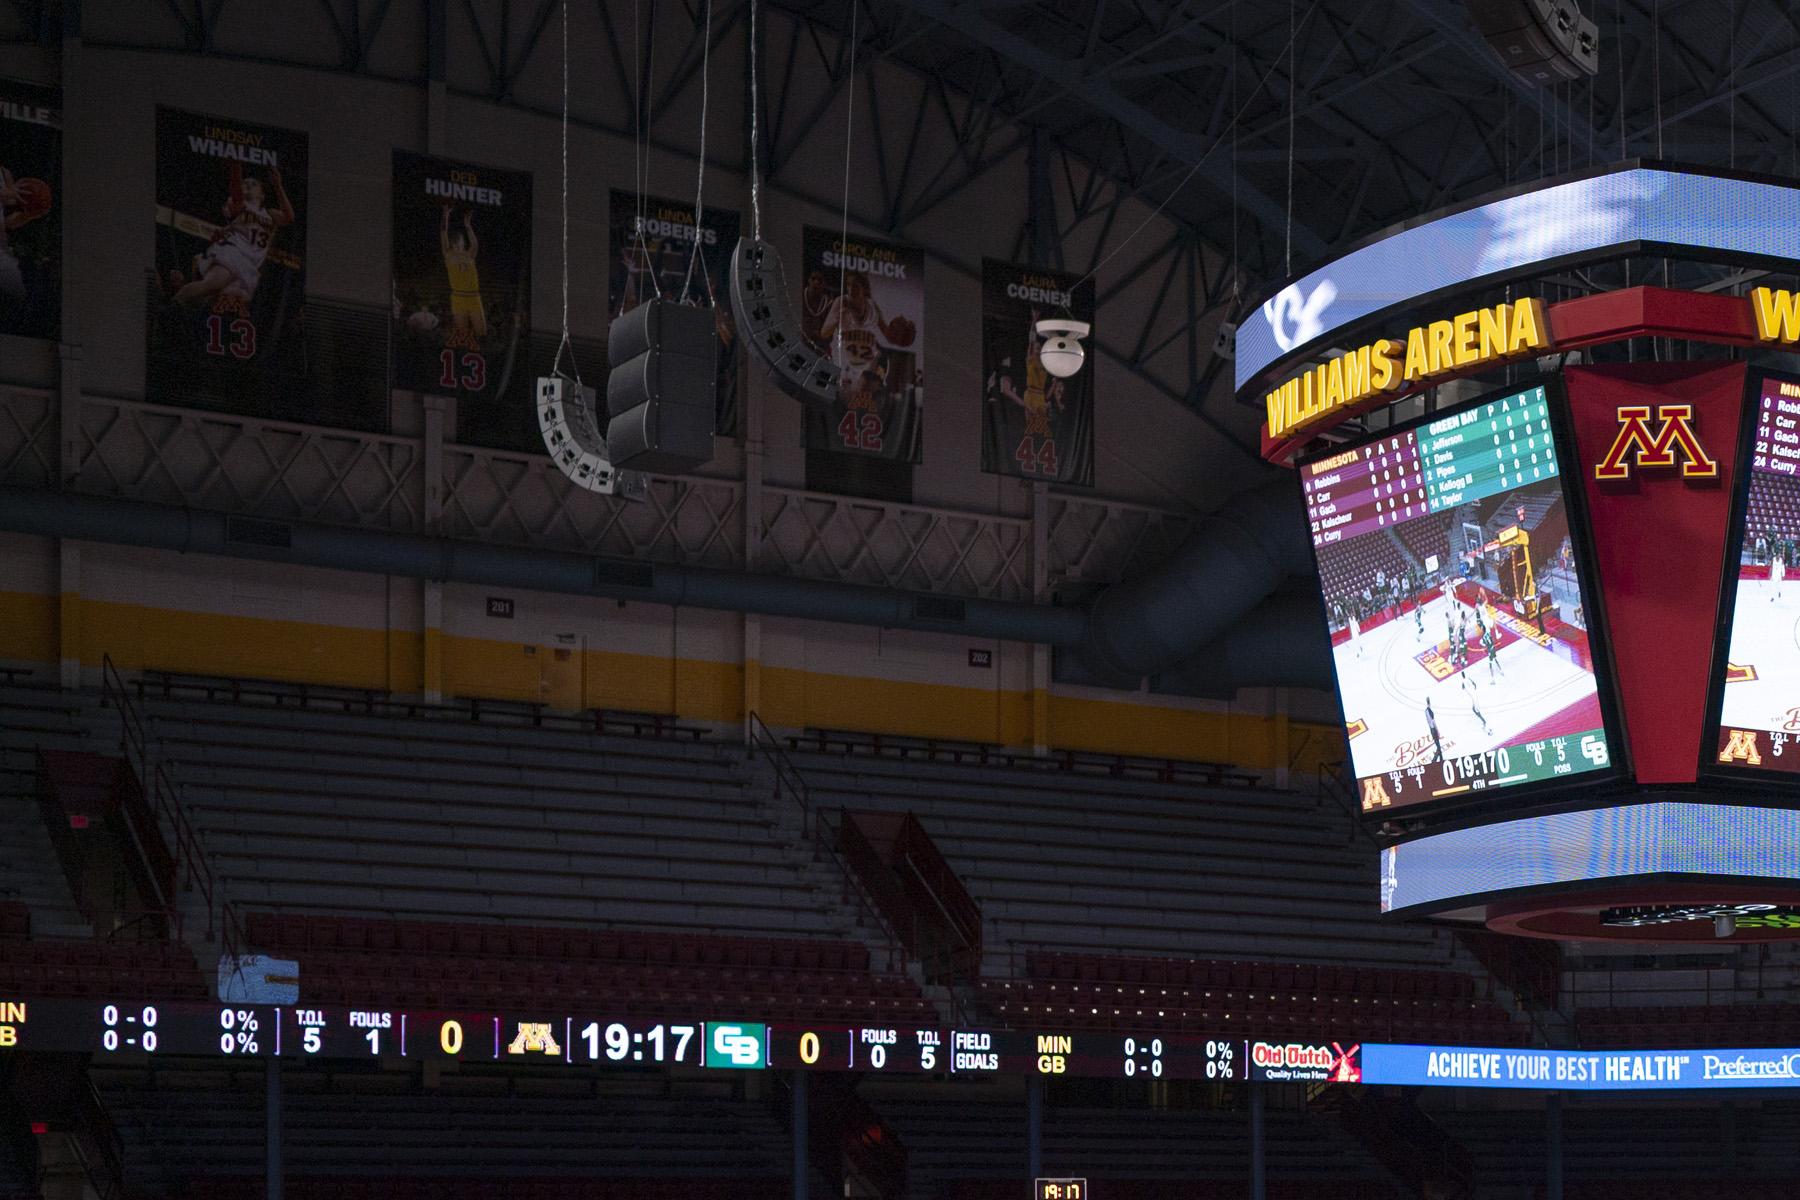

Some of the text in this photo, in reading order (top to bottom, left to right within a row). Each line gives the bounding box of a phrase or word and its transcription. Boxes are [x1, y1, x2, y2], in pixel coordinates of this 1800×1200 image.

[204, 126, 263, 148] LINDSAY
[189, 135, 278, 166] WHALEN
[450, 170, 478, 184] DEB
[426, 177, 501, 206] HUNTER
[657, 208, 693, 223] LINDA
[634, 215, 717, 245] ROBERTS
[822, 250, 905, 280] SHUDLICK
[206, 315, 256, 358] 13
[440, 349, 487, 390] 13
[1266, 297, 1545, 438] WILLIAMS ARENA
[838, 412, 883, 450] 42
[1776, 415, 1796, 429] Carr
[1756, 441, 1768, 453] 22
[1774, 430, 1799, 444] Gach
[1016, 435, 1058, 475] 44
[1312, 450, 1359, 475] MINNESOTA
[1754, 456, 1797, 473] 24 Curry
[220, 1009, 259, 1030] 0%
[350, 1011, 392, 1028] FOULS
[220, 1032, 259, 1053] 0%
[303, 1028, 321, 1053] 5
[366, 1029, 379, 1054] 1
[440, 1020, 463, 1054] 0
[580, 1023, 694, 1062] 19:17
[713, 1026, 760, 1065] GB
[800, 1032, 819, 1064] 0
[862, 1029, 897, 1045] FOULS
[956, 1033, 990, 1050] FIELD
[1037, 1035, 1072, 1054] MIN
[871, 1045, 886, 1069] 0
[921, 1046, 936, 1069] 5
[956, 1053, 998, 1071] GOALS
[1206, 1041, 1233, 1060] 0%
[1252, 1042, 1333, 1069] Old Dutch
[1037, 1055, 1066, 1073] GB
[1206, 1060, 1233, 1078] 0%
[1266, 1068, 1328, 1080] Quality Lives Here
[1427, 1051, 1501, 1080] ACHIEVE
[1505, 1054, 1551, 1081] YOUR
[1555, 1055, 1600, 1081] BEST
[1044, 1183, 1080, 1200] 19:17
